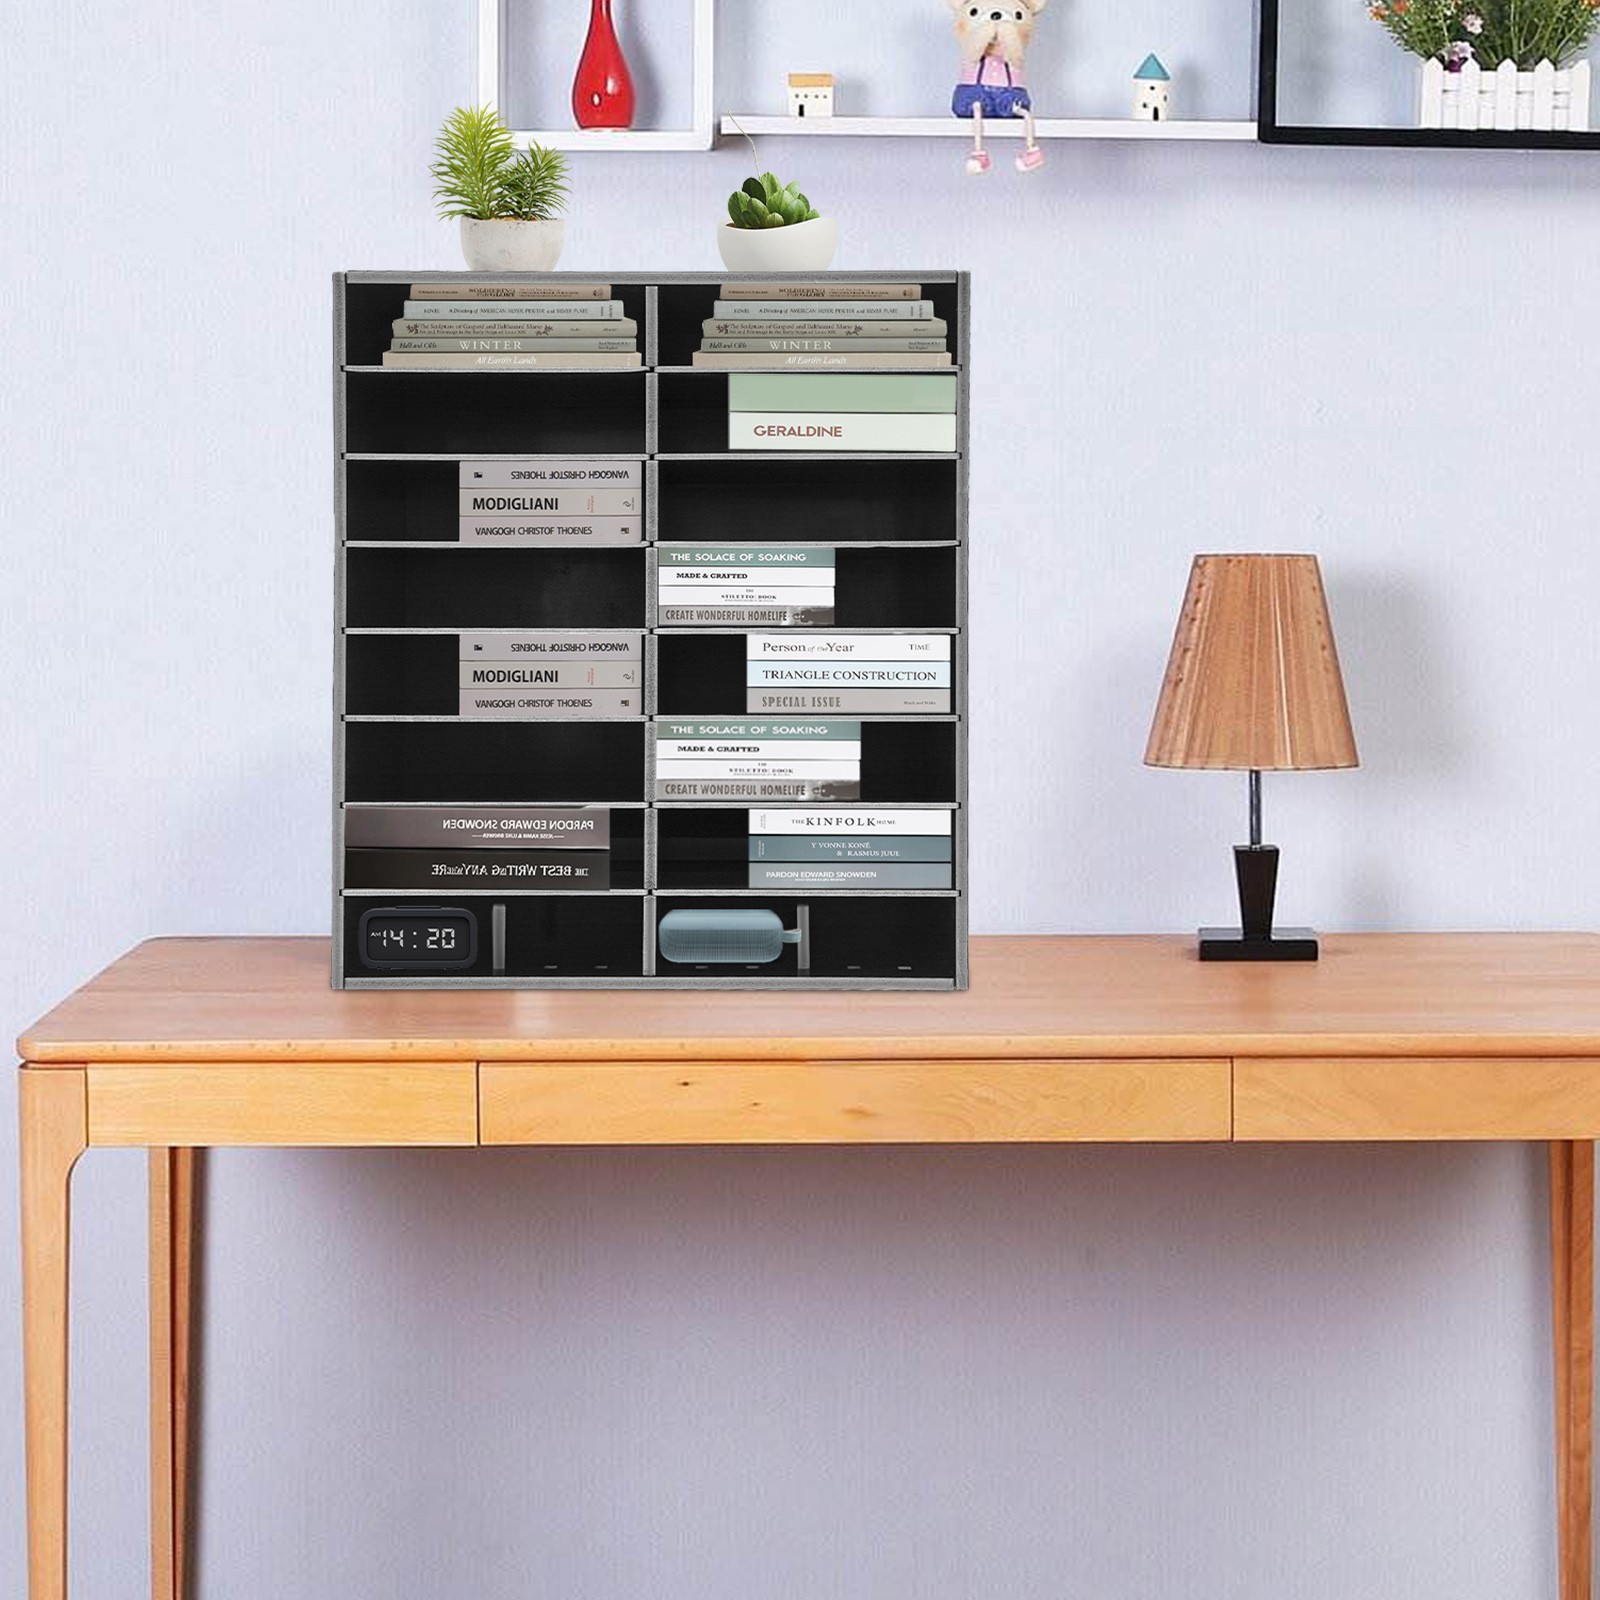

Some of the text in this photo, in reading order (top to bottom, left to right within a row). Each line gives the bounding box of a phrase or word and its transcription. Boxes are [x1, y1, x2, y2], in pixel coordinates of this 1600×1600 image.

[459, 341, 521, 350] WINTER
[769, 341, 831, 350] WINTER
[513, 356, 537, 364] Lands
[823, 356, 847, 364] Lands
[753, 425, 843, 437] GERALDINE
[511, 471, 629, 479] VANGOGH CHRISTOF THOENES
[472, 498, 559, 510] MODIGLIANI
[475, 527, 593, 536] VANGOGH CHRISTOF THOENES
[671, 553, 807, 562] THE SOLACE OF SOAKING
[665, 610, 787, 621] CREATE WONDERFUL HOMELIFE
[511, 643, 629, 651] VANGOGH CHRISTOF THOENES
[763, 643, 806, 652] Person
[807, 645, 815, 653] of
[826, 643, 855, 652] Year
[472, 670, 559, 682] MODIGLIANI
[763, 670, 937, 681] TRIANGLE CONSTRUCTION
[475, 699, 593, 708] VANGOGH CHRISTOF THOENES
[762, 696, 841, 708] SPECIAL ISSUE
[670, 726, 828, 734] THE SOLACE OF SOAKING
[665, 784, 806, 796] CREATE WONDERFUL HOMELIFE
[806, 817, 876, 827] KINFOLK
